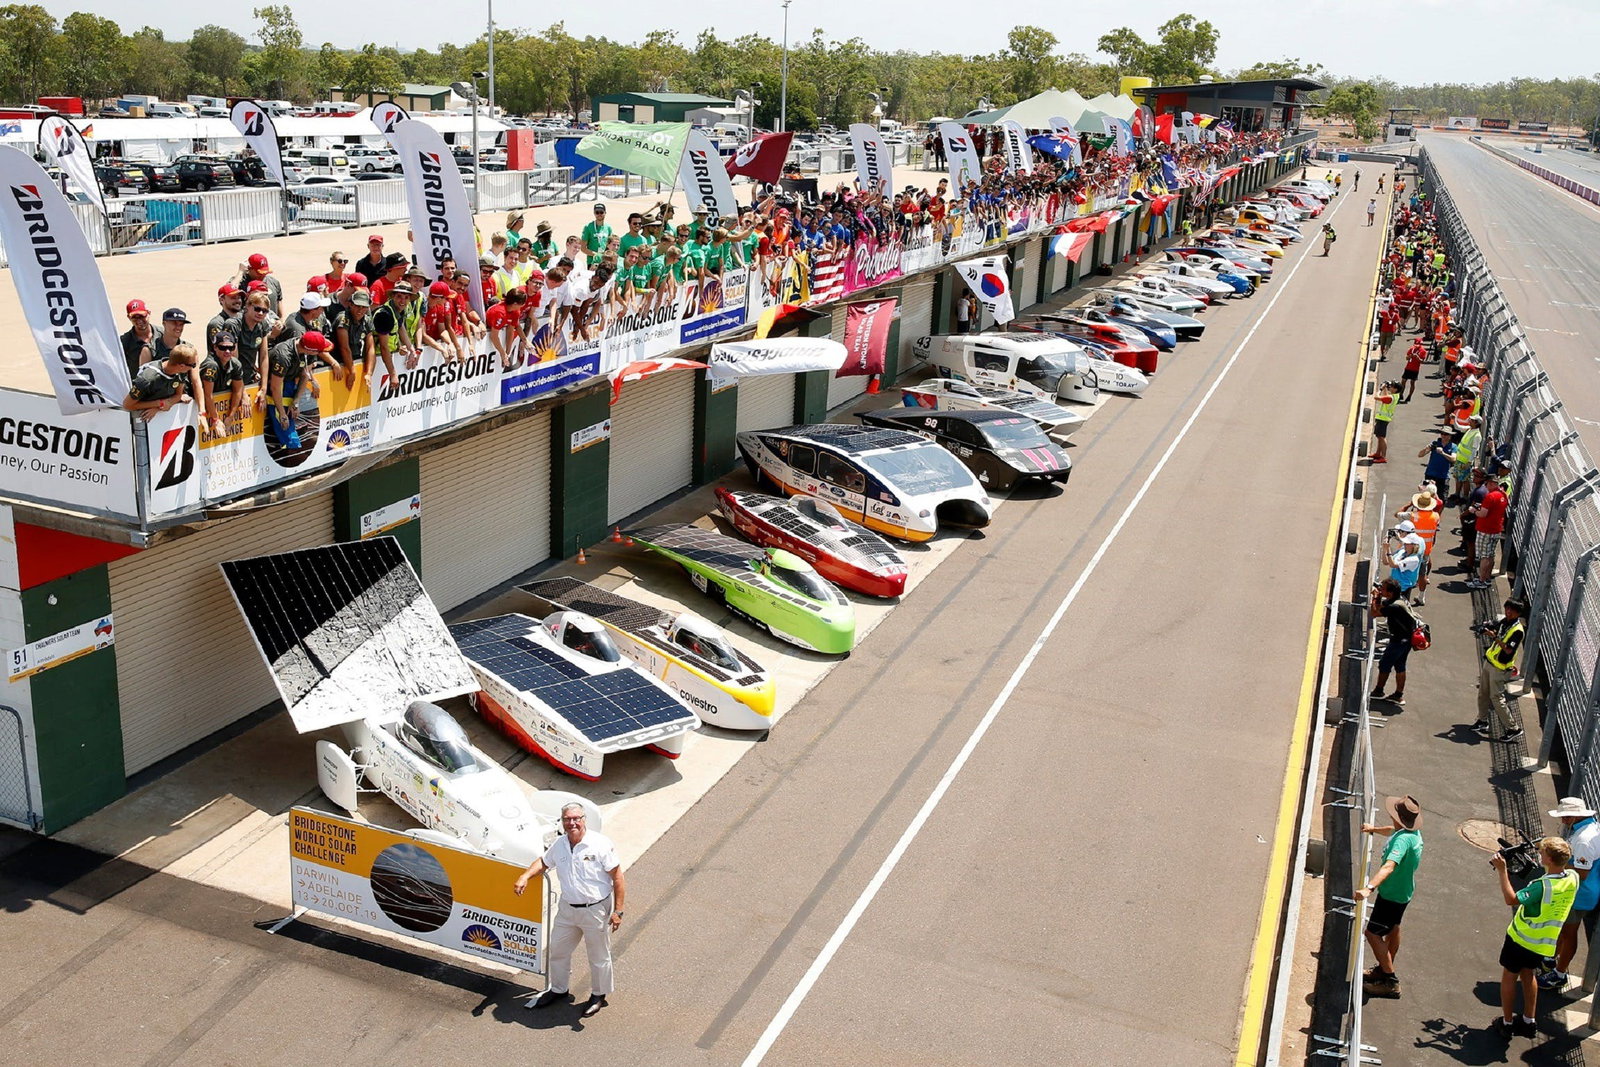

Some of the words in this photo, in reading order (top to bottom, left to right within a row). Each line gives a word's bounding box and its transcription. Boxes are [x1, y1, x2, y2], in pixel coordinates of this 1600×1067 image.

[725, 274, 747, 288] WORLD
[10, 184, 106, 405] BRIDGESTONE
[725, 285, 745, 299] SOLAR
[605, 303, 679, 340] BRIDGESTONE
[568, 340, 599, 355] CHALLENGE
[916, 336, 932, 349] 43
[273, 363, 285, 373] 51
[377, 351, 496, 402] BRIDGESTONE
[509, 362, 594, 394] www.worldsolarchallenge.org
[387, 406, 407, 418] Your
[408, 396, 443, 414] Journey,
[443, 391, 458, 402] Our
[461, 382, 489, 396] Passion
[326, 410, 370, 430] BRIDGESTONE
[924, 417, 938, 429] 98
[0, 417, 121, 465] GESTONE
[31, 458, 56, 475] Our
[60, 463, 109, 486] Passion
[807, 483, 818, 494] 3M
[363, 515, 372, 527] 92
[70, 629, 81, 638] TEAM
[14, 649, 27, 665] 51
[680, 689, 718, 714] covestro
[572, 753, 584, 766] M
[294, 816, 356, 841] BRIDGESTONE
[420, 808, 433, 829] 51
[294, 829, 325, 846] WORLD
[328, 837, 357, 855] SOLAR
[294, 841, 345, 865] CHALLENGE
[296, 865, 339, 886] DARWIN
[297, 890, 309, 902] 13
[308, 881, 362, 905] ADELAIDE
[461, 908, 538, 936] BRIDGESTONE
[503, 931, 538, 947] WORLD
[503, 940, 537, 955] SOLAR
[463, 943, 535, 967] worldsolarchallenge.org
[503, 947, 538, 960] CHALLENGE
